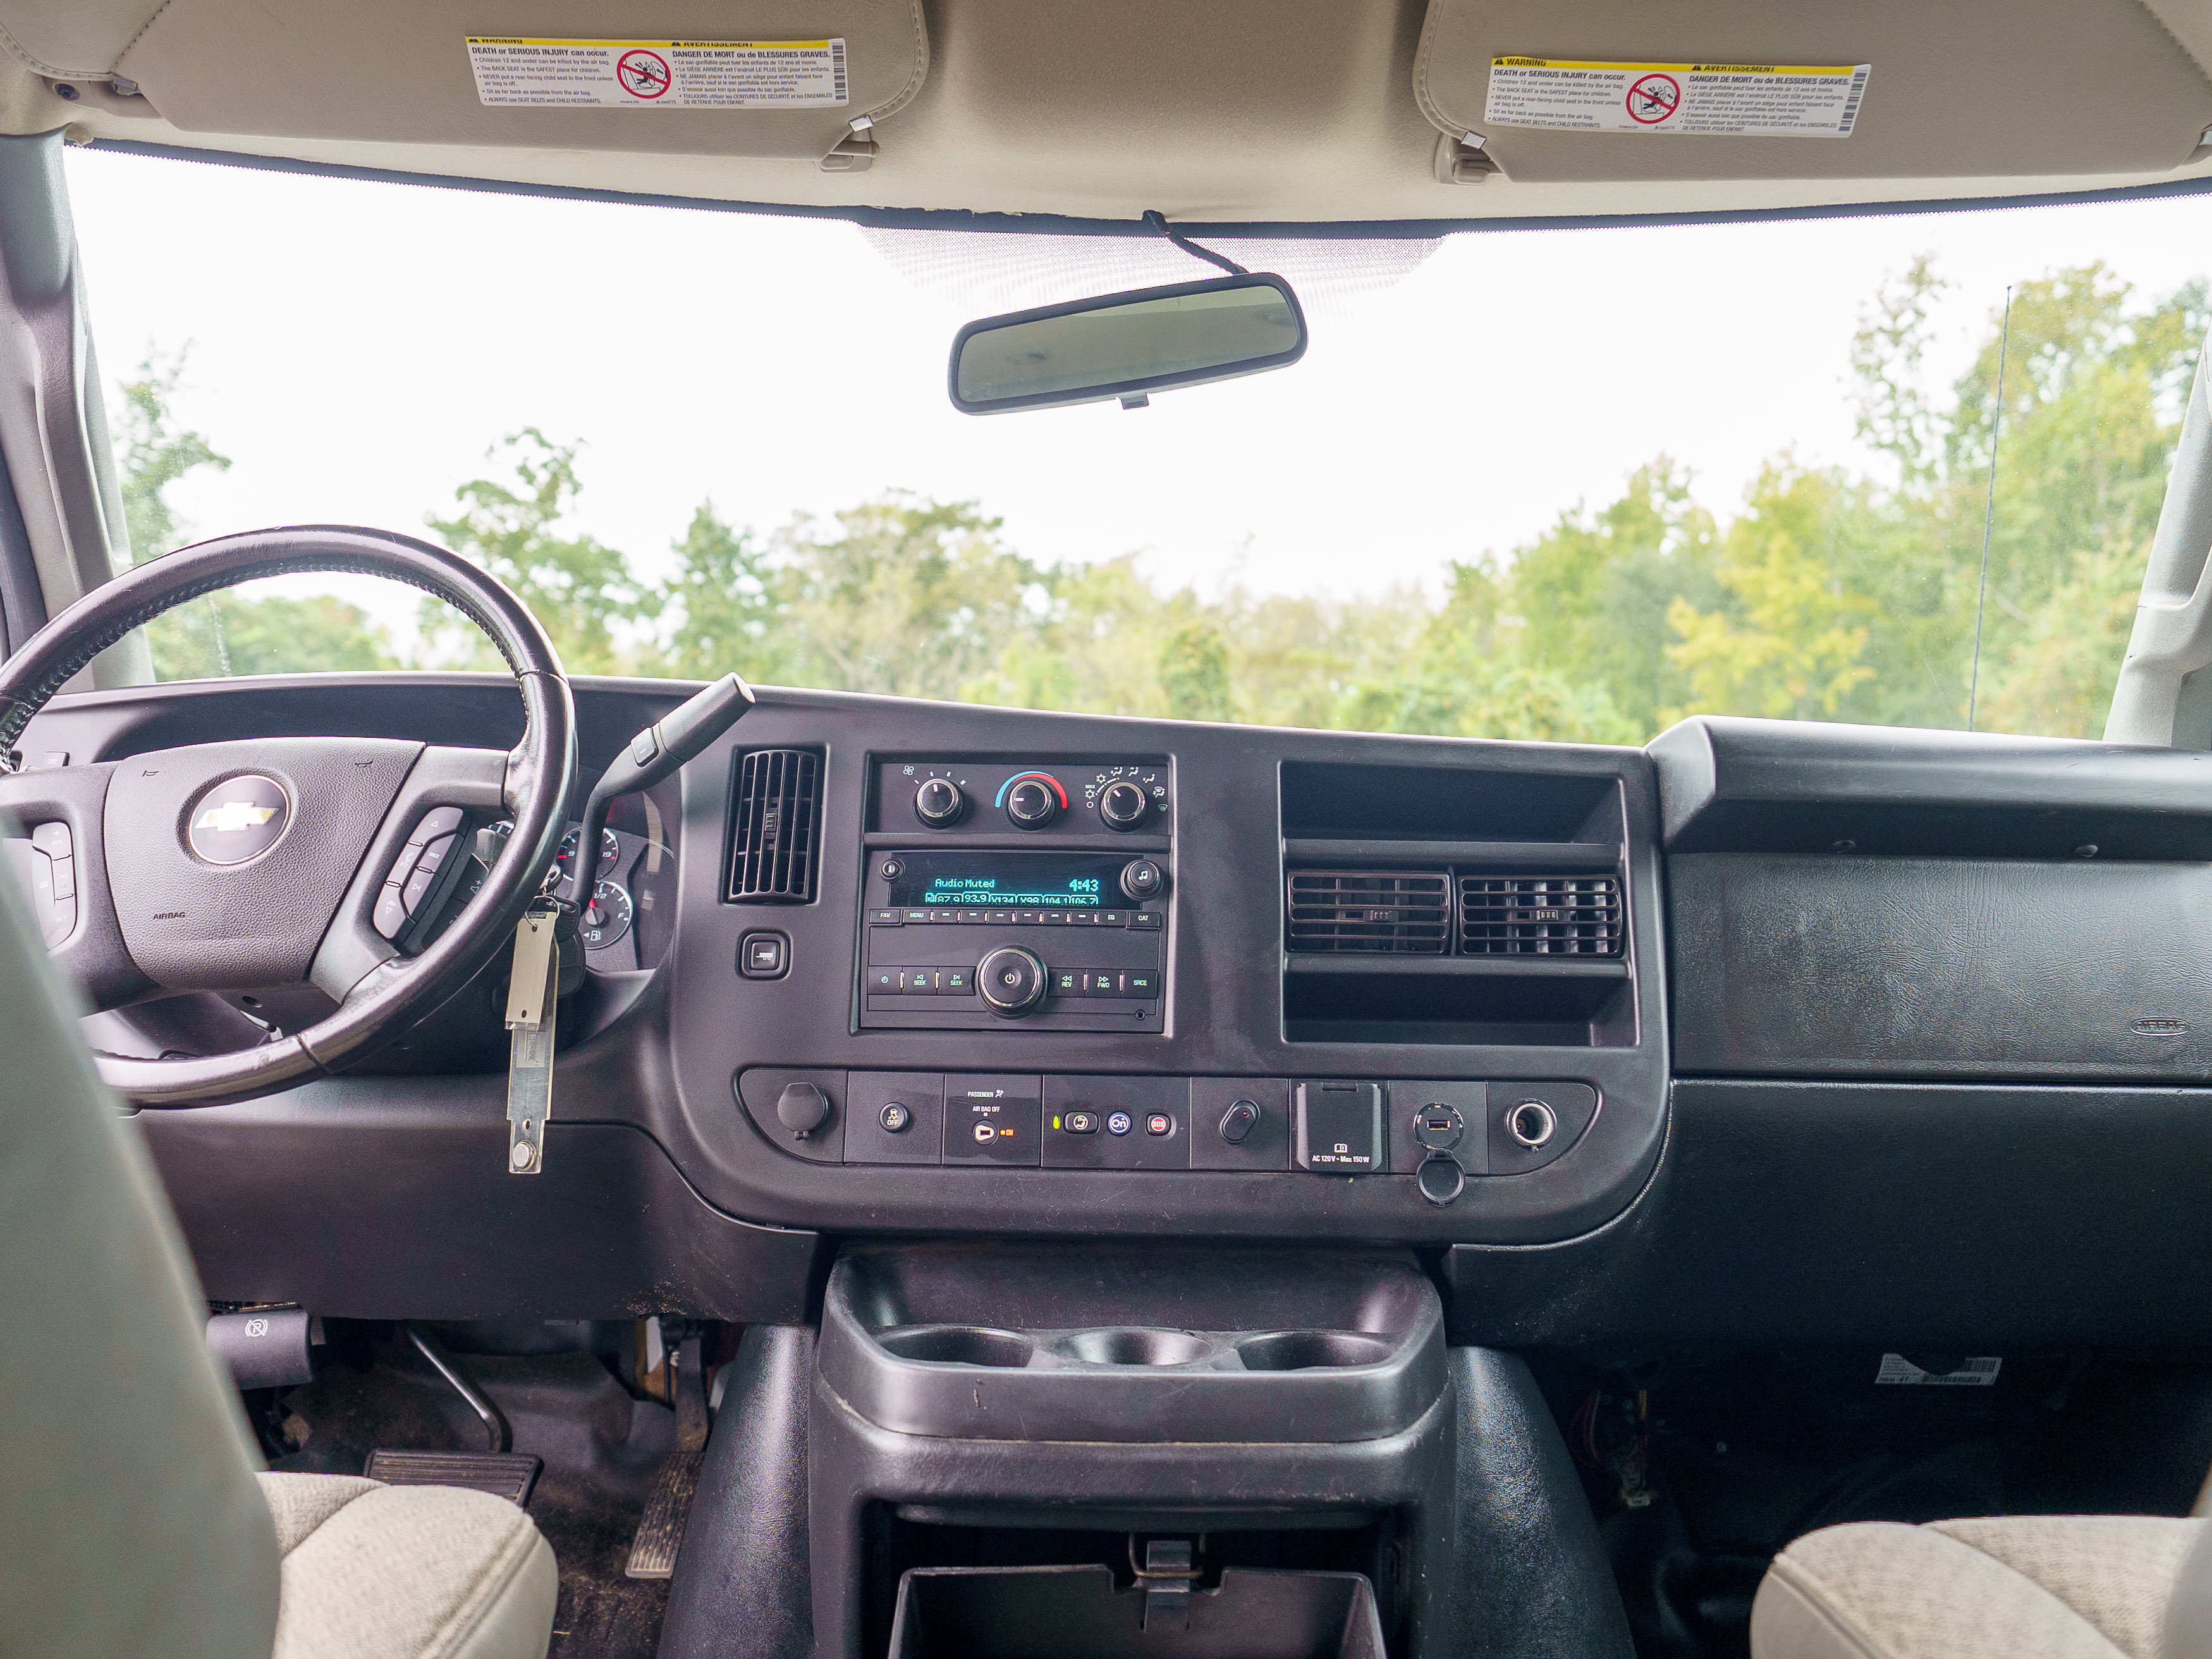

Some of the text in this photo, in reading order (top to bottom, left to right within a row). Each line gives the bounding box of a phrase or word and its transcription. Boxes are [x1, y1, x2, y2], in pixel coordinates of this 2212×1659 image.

[1507, 58, 1546, 66] WARNING
[935, 878, 995, 888] Audio Muted
[1069, 879, 1099, 892] 4:43
[965, 894, 987, 903] 93.9
[2137, 1022, 2185, 1031] AIRBAG
